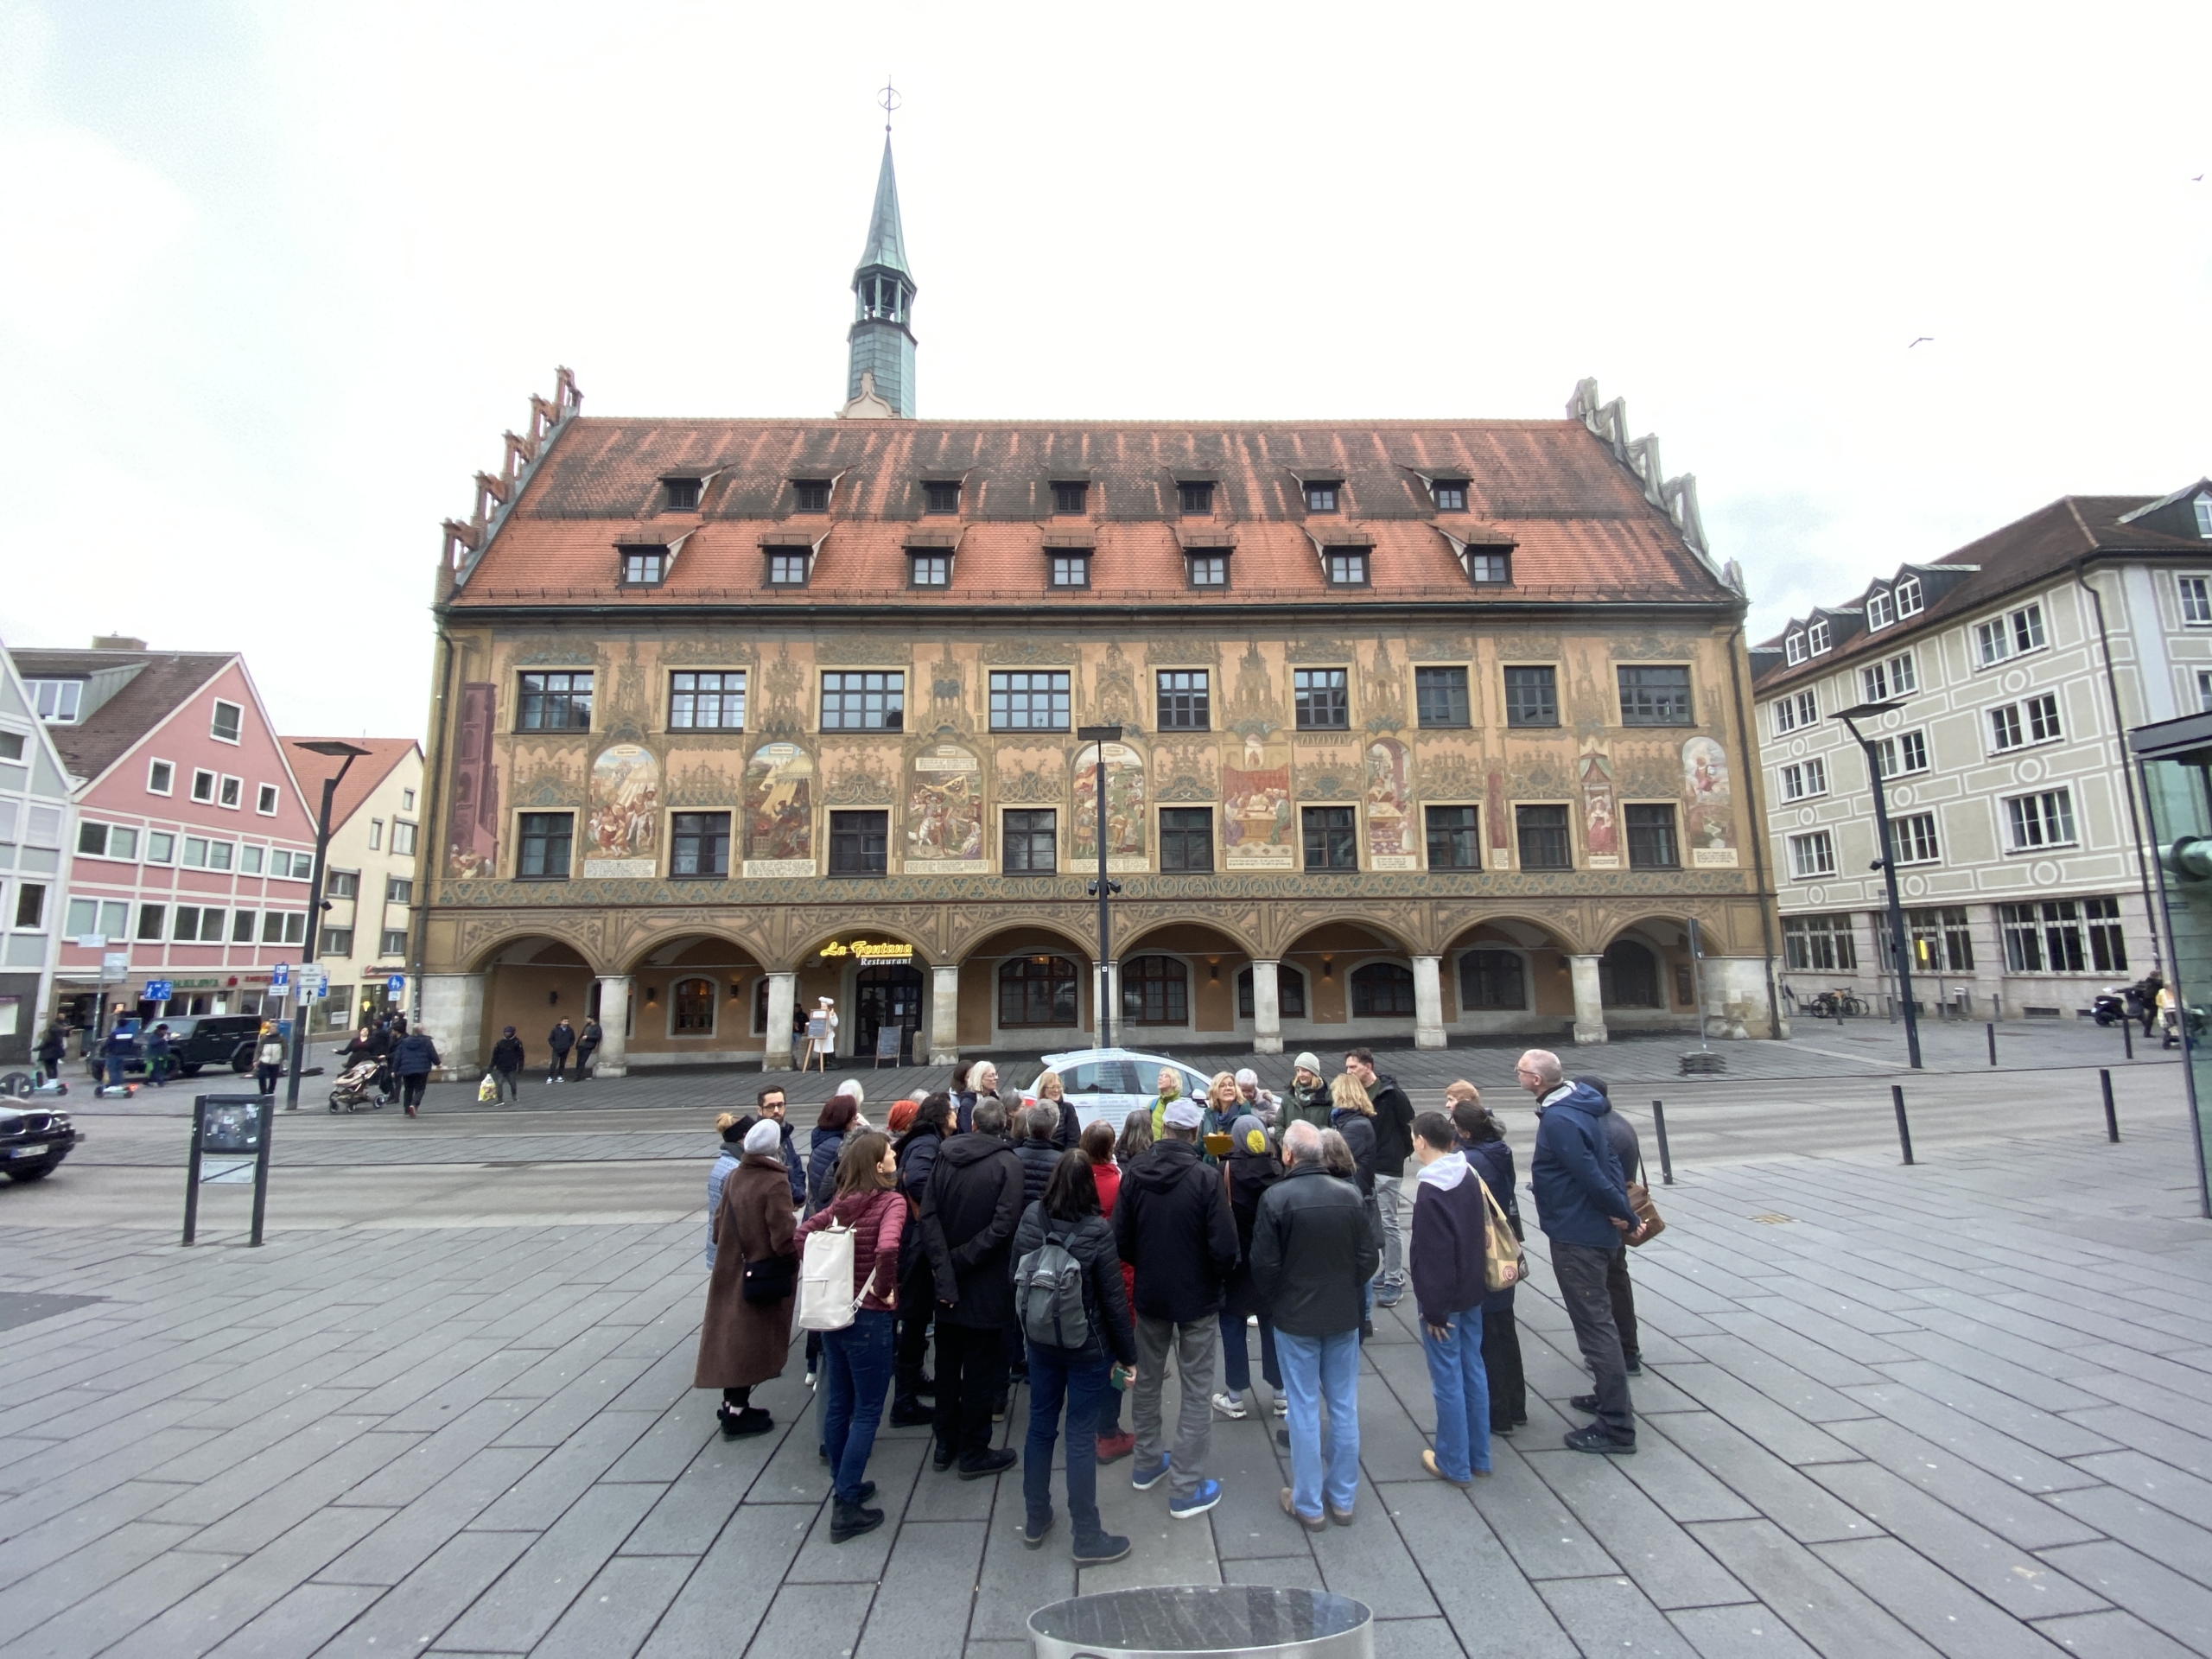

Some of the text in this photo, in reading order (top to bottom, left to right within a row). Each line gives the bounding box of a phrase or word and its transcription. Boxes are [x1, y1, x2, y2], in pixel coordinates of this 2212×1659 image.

[820, 940, 912, 958] La Fontana
[861, 957, 911, 966] Restaurant
